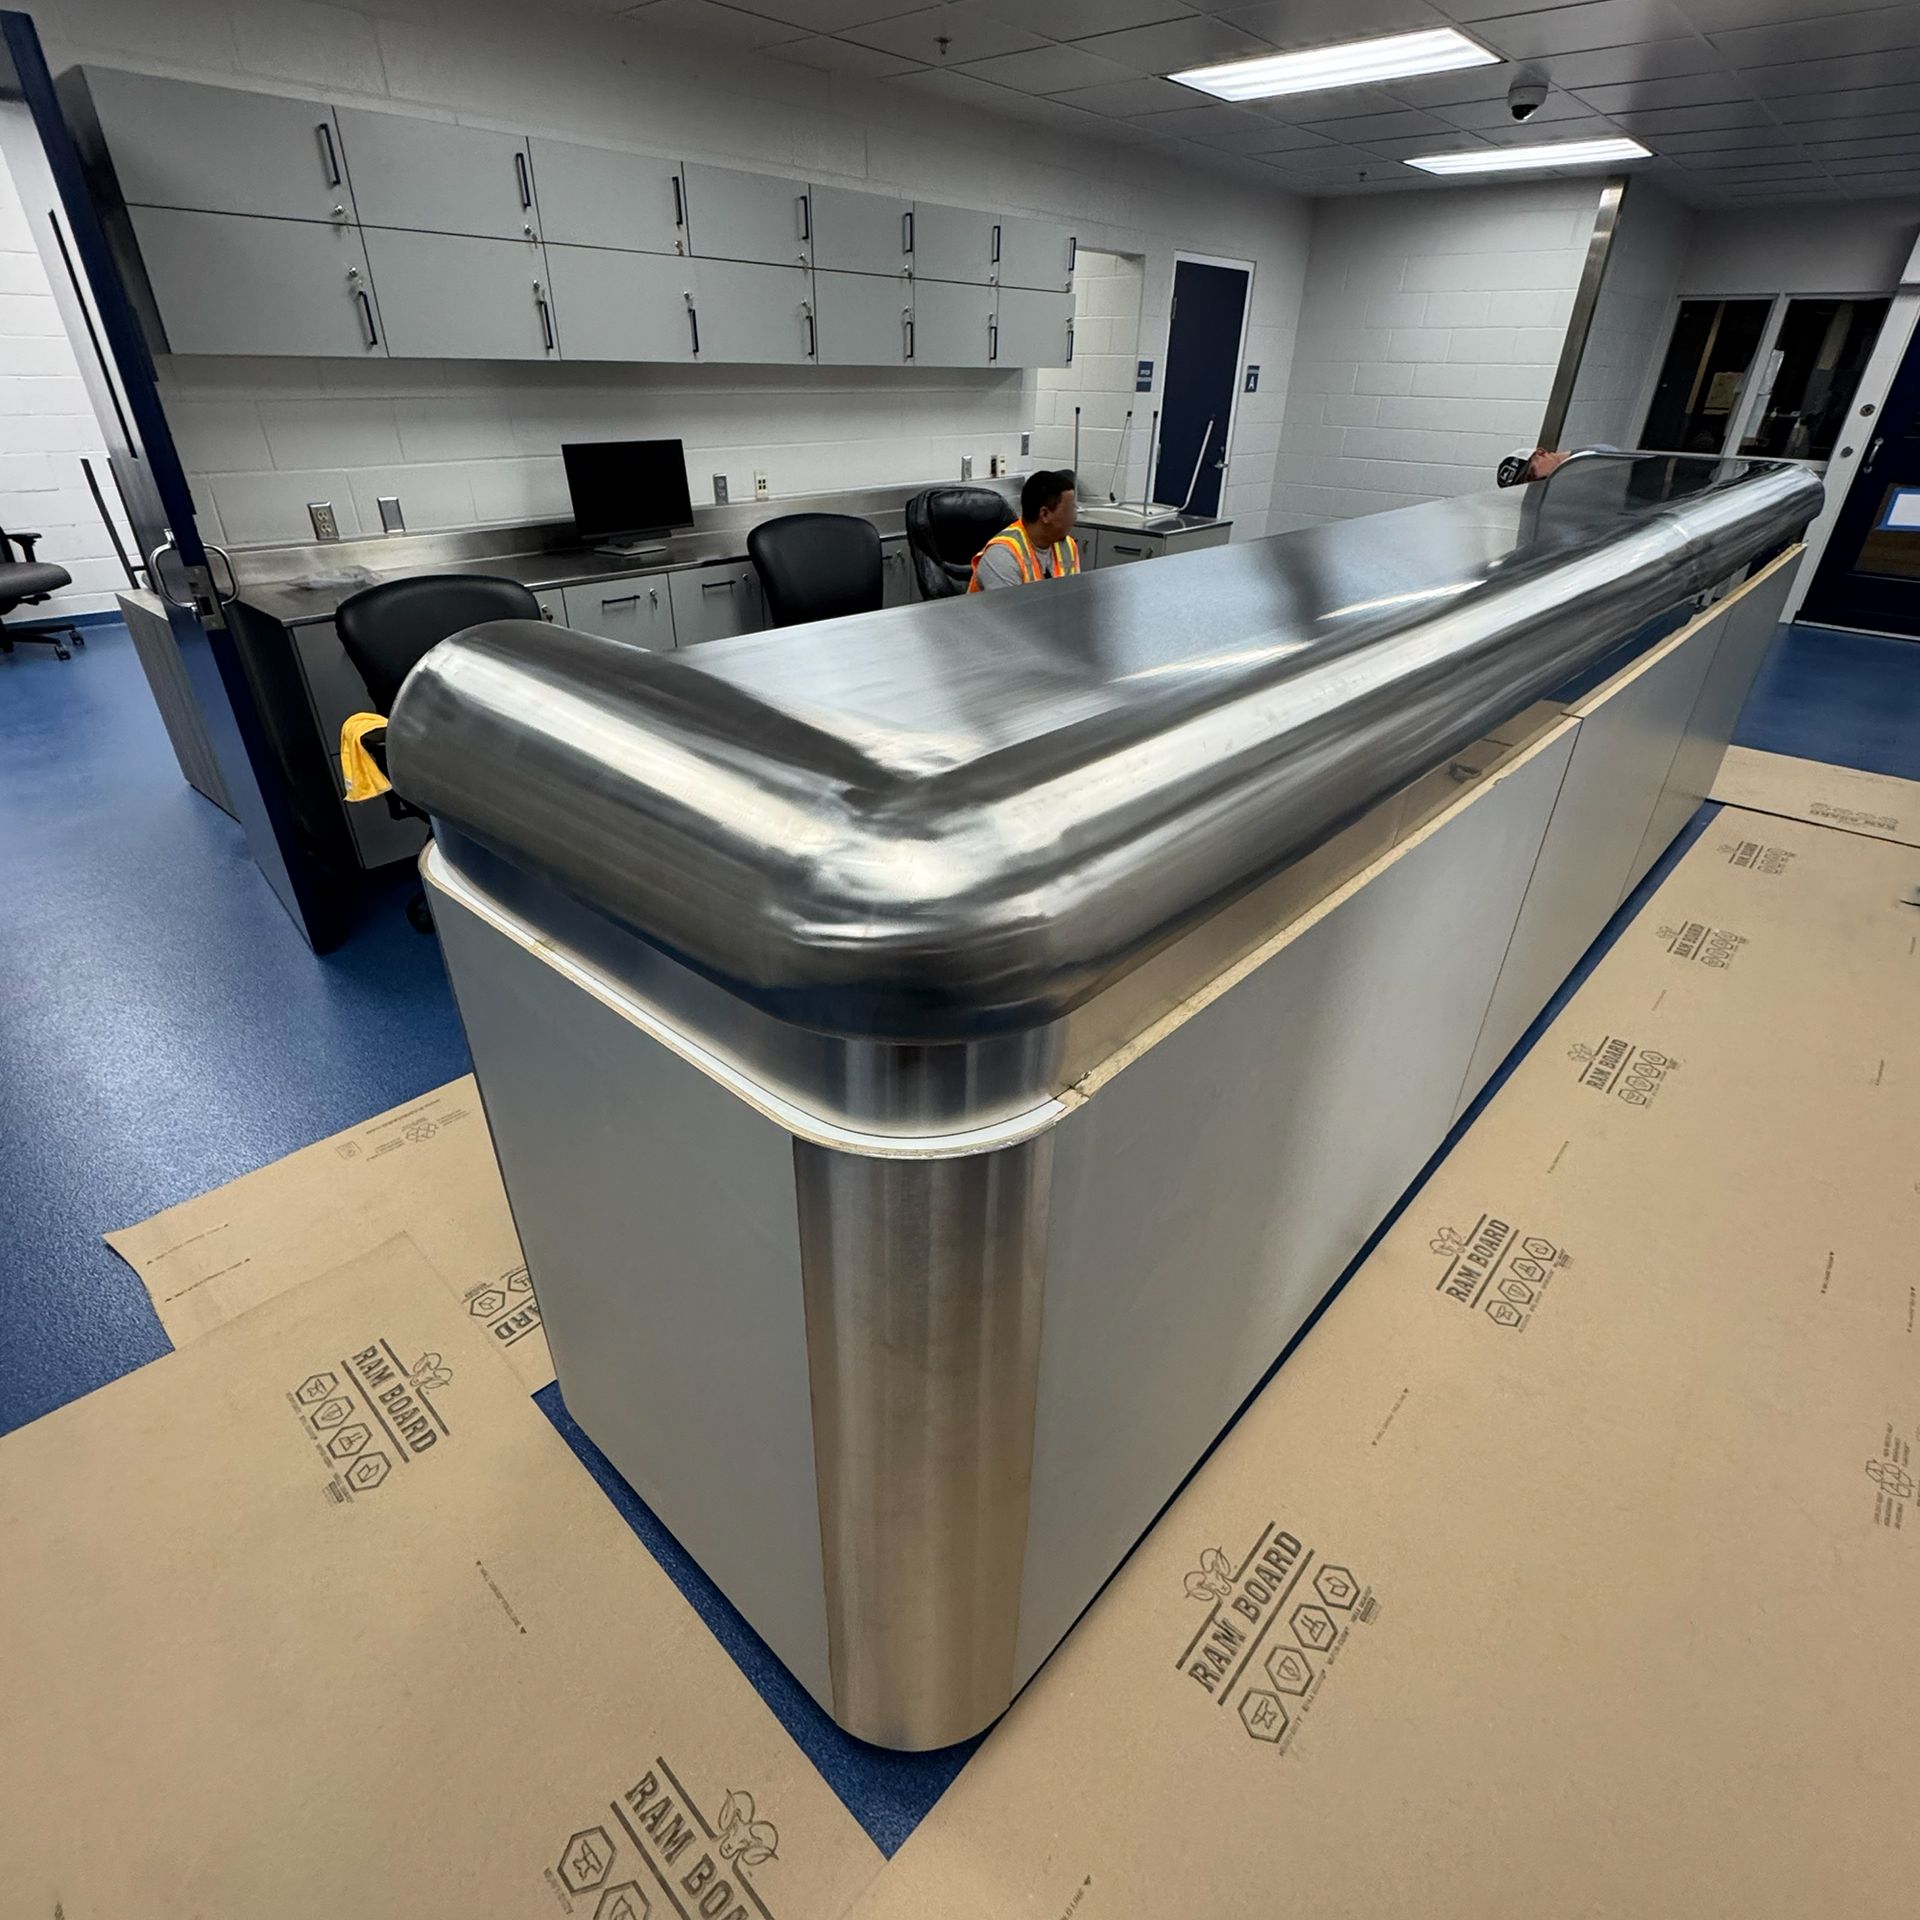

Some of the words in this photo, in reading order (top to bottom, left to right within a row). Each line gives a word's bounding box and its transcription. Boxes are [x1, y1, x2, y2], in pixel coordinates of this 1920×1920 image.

[1248, 375, 1254, 389] A
[1585, 1067, 1612, 1091] RAM
[1599, 1039, 1628, 1070] BOARD
[1445, 1264, 1482, 1303] RAM
[1467, 1219, 1510, 1268] BOARD
[352, 1345, 395, 1388] RAM
[378, 1382, 438, 1453] BOARD
[1188, 1618, 1246, 1694] RAM
[1231, 1531, 1302, 1625] BOARD
[625, 1770, 697, 1866] RAM
